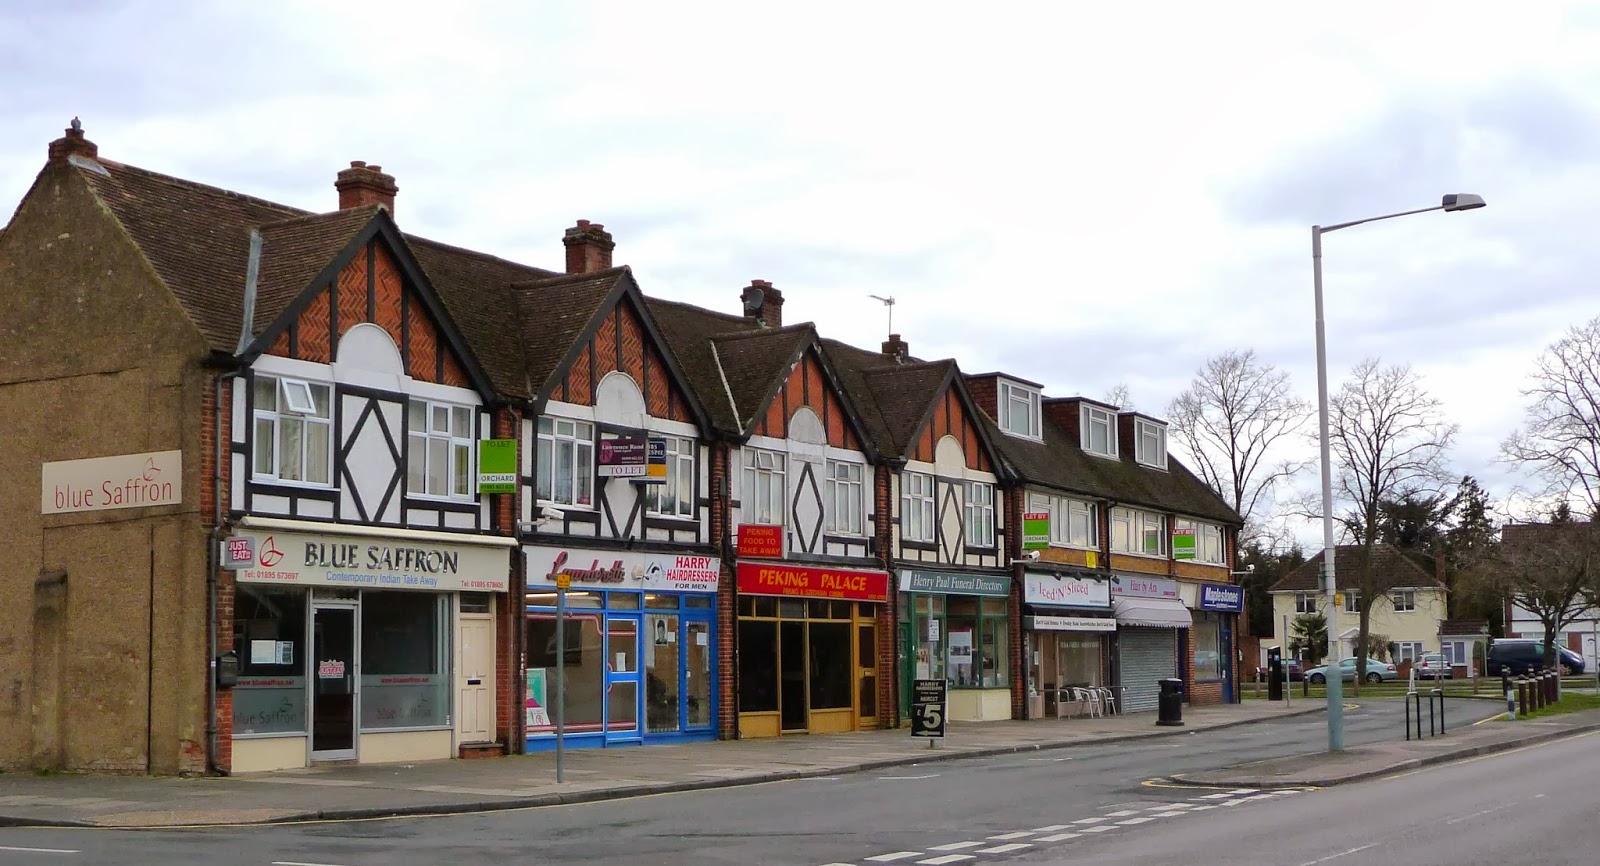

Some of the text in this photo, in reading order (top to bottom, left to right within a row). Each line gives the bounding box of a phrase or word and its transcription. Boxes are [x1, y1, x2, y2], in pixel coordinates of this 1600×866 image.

[55, 478, 172, 508] blue Saffron
[229, 541, 247, 550] JUST
[233, 551, 246, 559] EAT
[304, 542, 458, 574] BLUE SAFFRON
[676, 556, 712, 569] HARRY
[326, 571, 438, 587] Contemporary Indian Take Away
[666, 569, 718, 582] HAIRDRESSERS
[759, 569, 867, 591] PEKING PALACE
[914, 574, 1003, 591] Henry Paul Funeral Directors
[1205, 586, 1238, 603] Maplestones
[259, 710, 297, 724] Saffron
